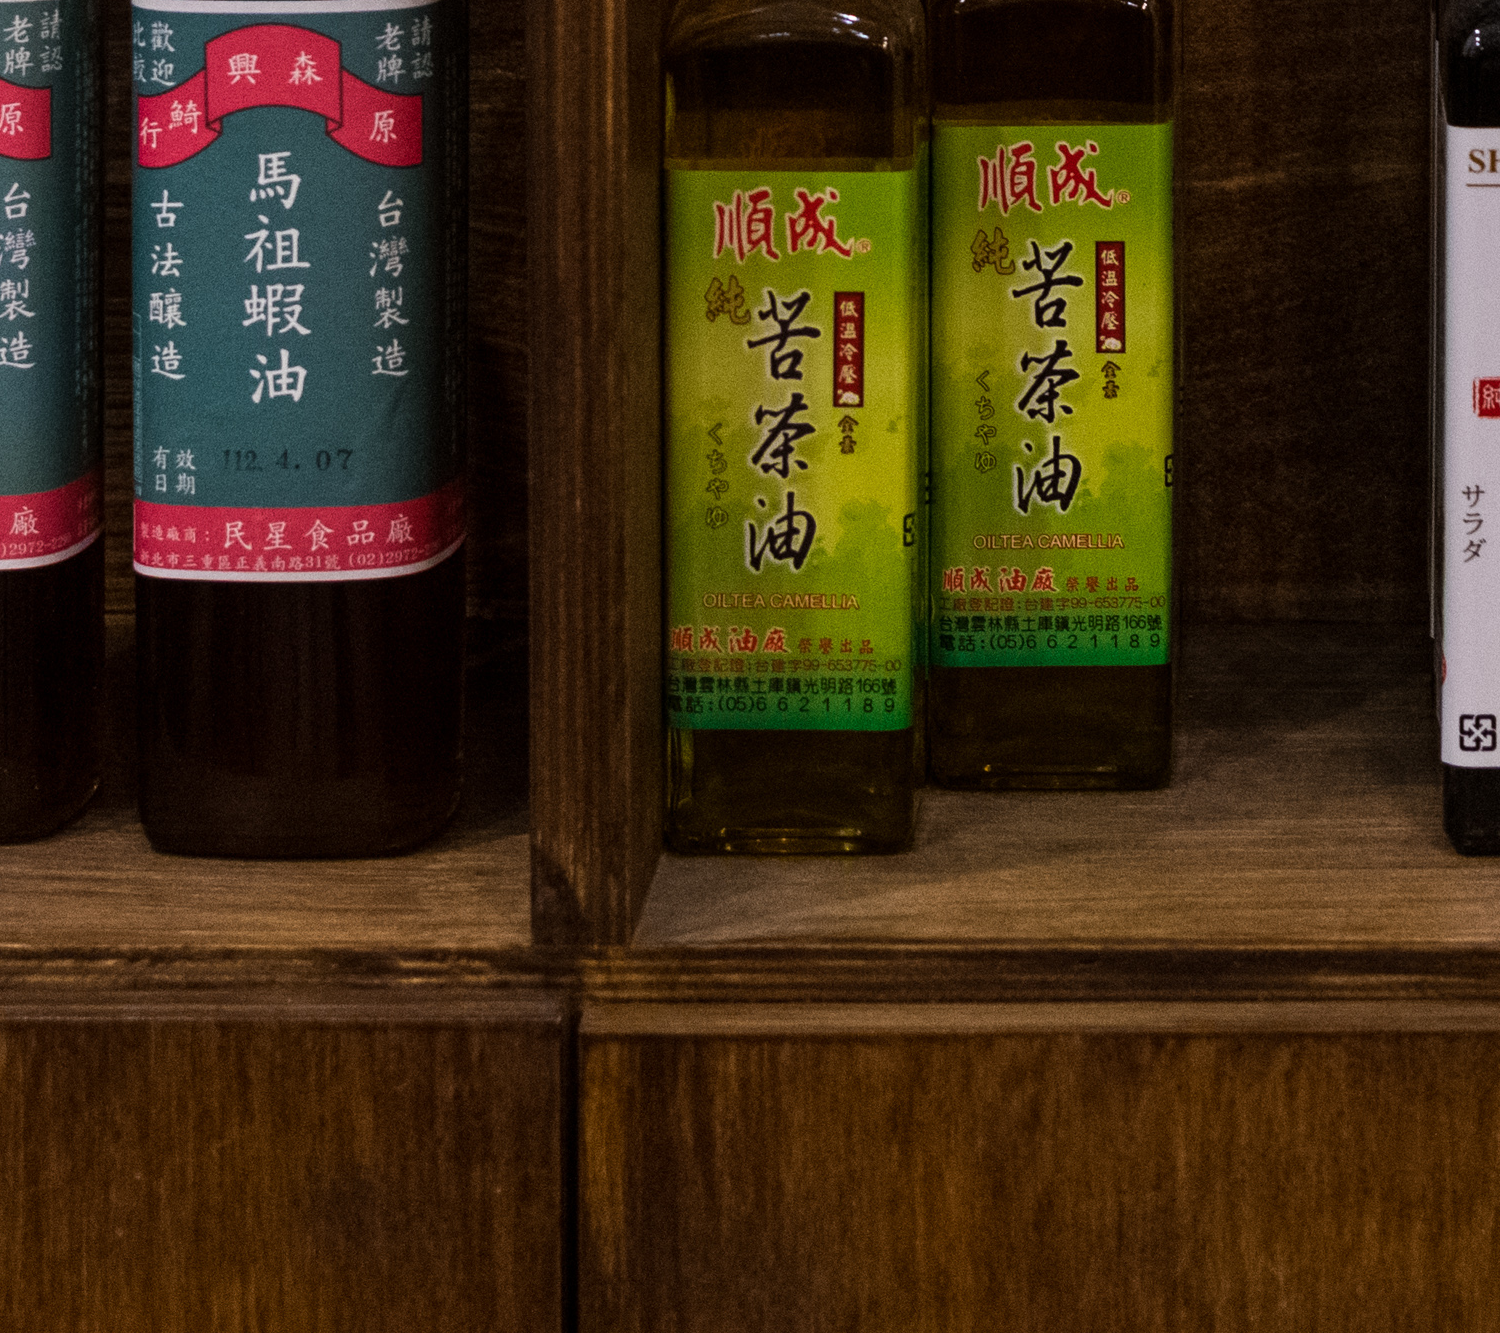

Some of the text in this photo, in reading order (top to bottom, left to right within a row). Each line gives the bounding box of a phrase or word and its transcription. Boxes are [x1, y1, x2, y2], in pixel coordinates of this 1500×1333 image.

[977, 139, 1115, 215] 順成
[713, 188, 855, 262] 順成
[148, 189, 188, 381] 古法釀造
[241, 150, 312, 404] 馬祖蝦油
[369, 189, 410, 379] 台灣製造
[1011, 238, 1085, 517] 苦茶油
[747, 288, 822, 573] 苦茶油
[223, 514, 416, 553] 民星食品廠
[972, 533, 1125, 550] OILTEA CAMELLIA
[1461, 483, 1488, 565] サラダ
[702, 592, 860, 610] OILTEA CAMELLIA
[941, 565, 1061, 595] 順成油廠
[669, 625, 792, 654] 順成油廠
